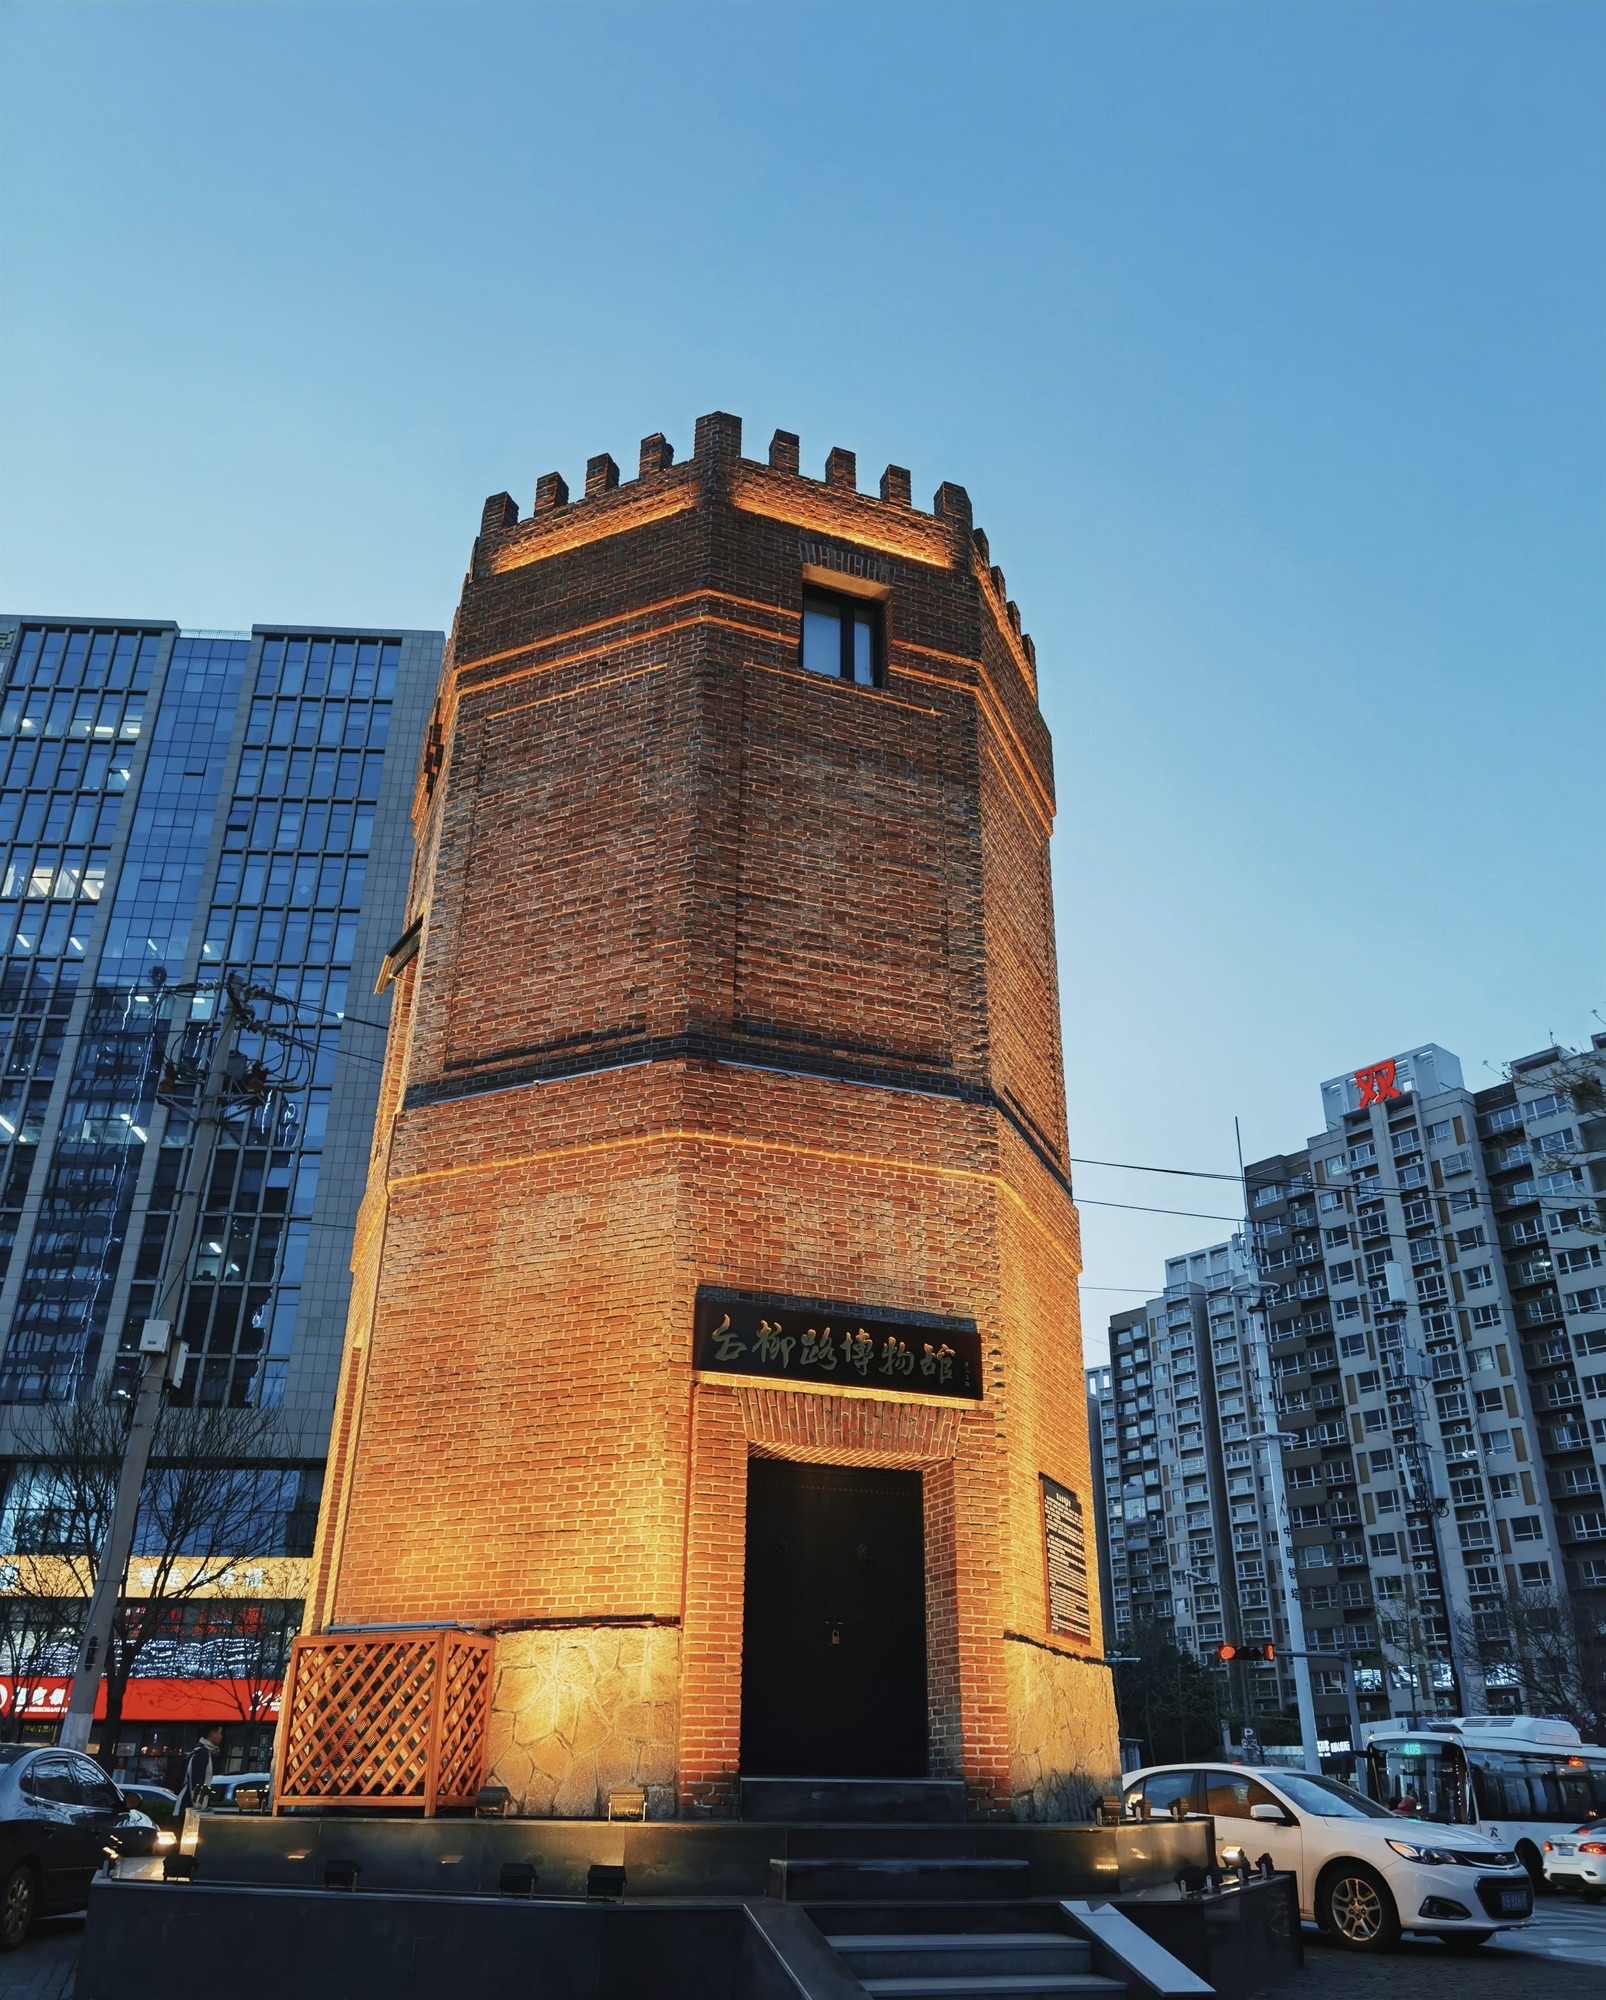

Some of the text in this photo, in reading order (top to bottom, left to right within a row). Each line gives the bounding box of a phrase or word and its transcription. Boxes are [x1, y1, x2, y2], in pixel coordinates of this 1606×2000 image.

[1355, 1059, 1402, 1109] 双
[1283, 1525, 1300, 1601] 中国铁塔
[1244, 1728, 1254, 1739] P
